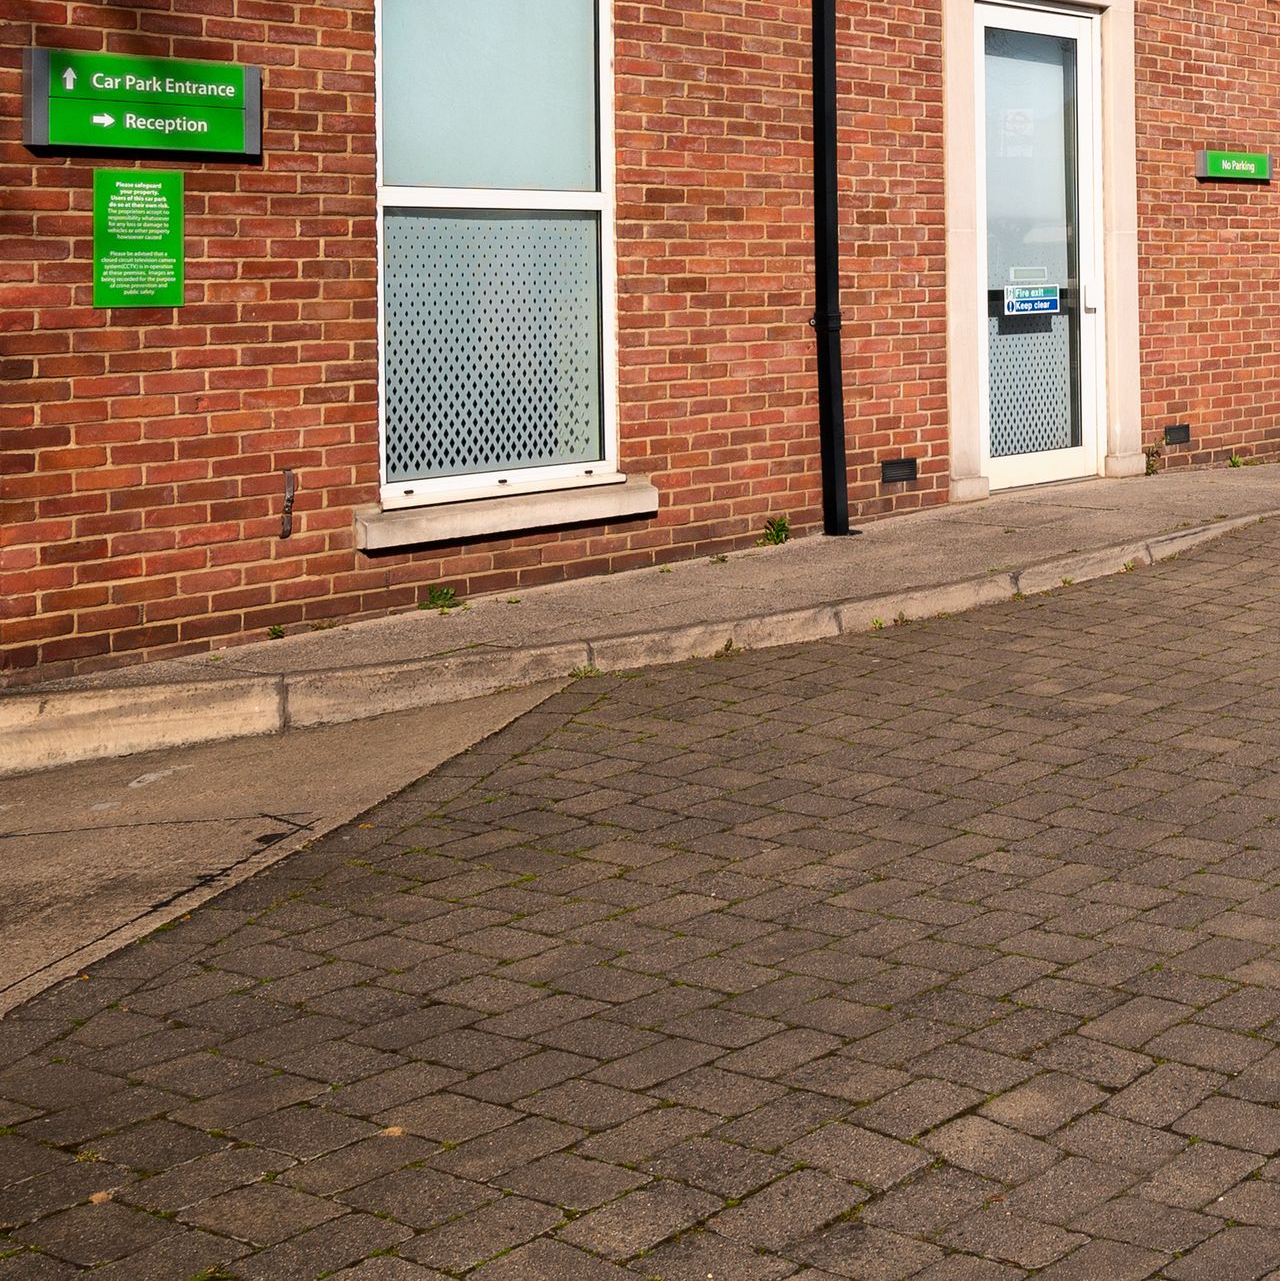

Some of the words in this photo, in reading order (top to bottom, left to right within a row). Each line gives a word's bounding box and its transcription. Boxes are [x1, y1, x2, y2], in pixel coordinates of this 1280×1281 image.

[92, 73, 122, 90] Car
[125, 75, 162, 92] Park
[166, 78, 235, 97] Entrance
[126, 114, 208, 134] Reception
[1222, 160, 1231, 170] No
[1232, 160, 1255, 174] Parking
[1016, 288, 1028, 297] Fire
[1030, 288, 1044, 297] exit
[1016, 302, 1032, 310] Keep
[1034, 301, 1050, 309] clear
